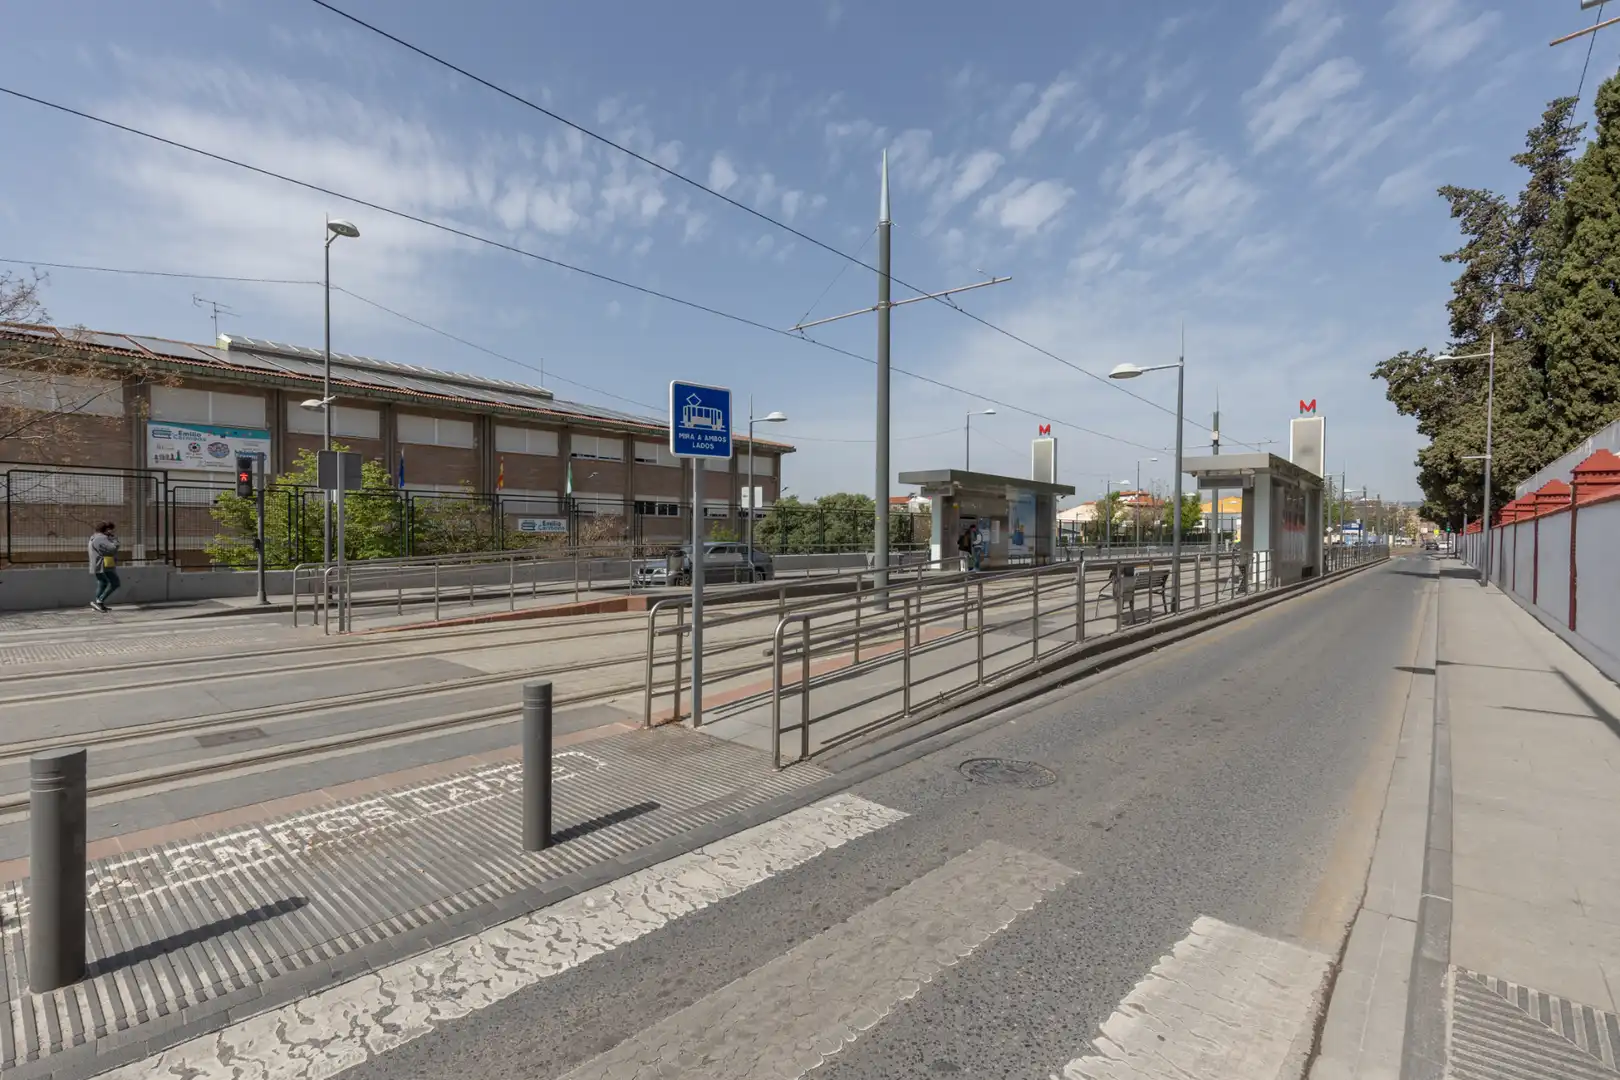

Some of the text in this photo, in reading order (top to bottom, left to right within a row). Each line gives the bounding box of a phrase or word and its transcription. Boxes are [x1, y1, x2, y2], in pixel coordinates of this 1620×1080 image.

[1299, 399, 1316, 414] M
[1039, 424, 1051, 436] M
[678, 432, 695, 440] MIRA
[704, 434, 726, 443] AMBOS
[692, 441, 714, 449] LADOS
